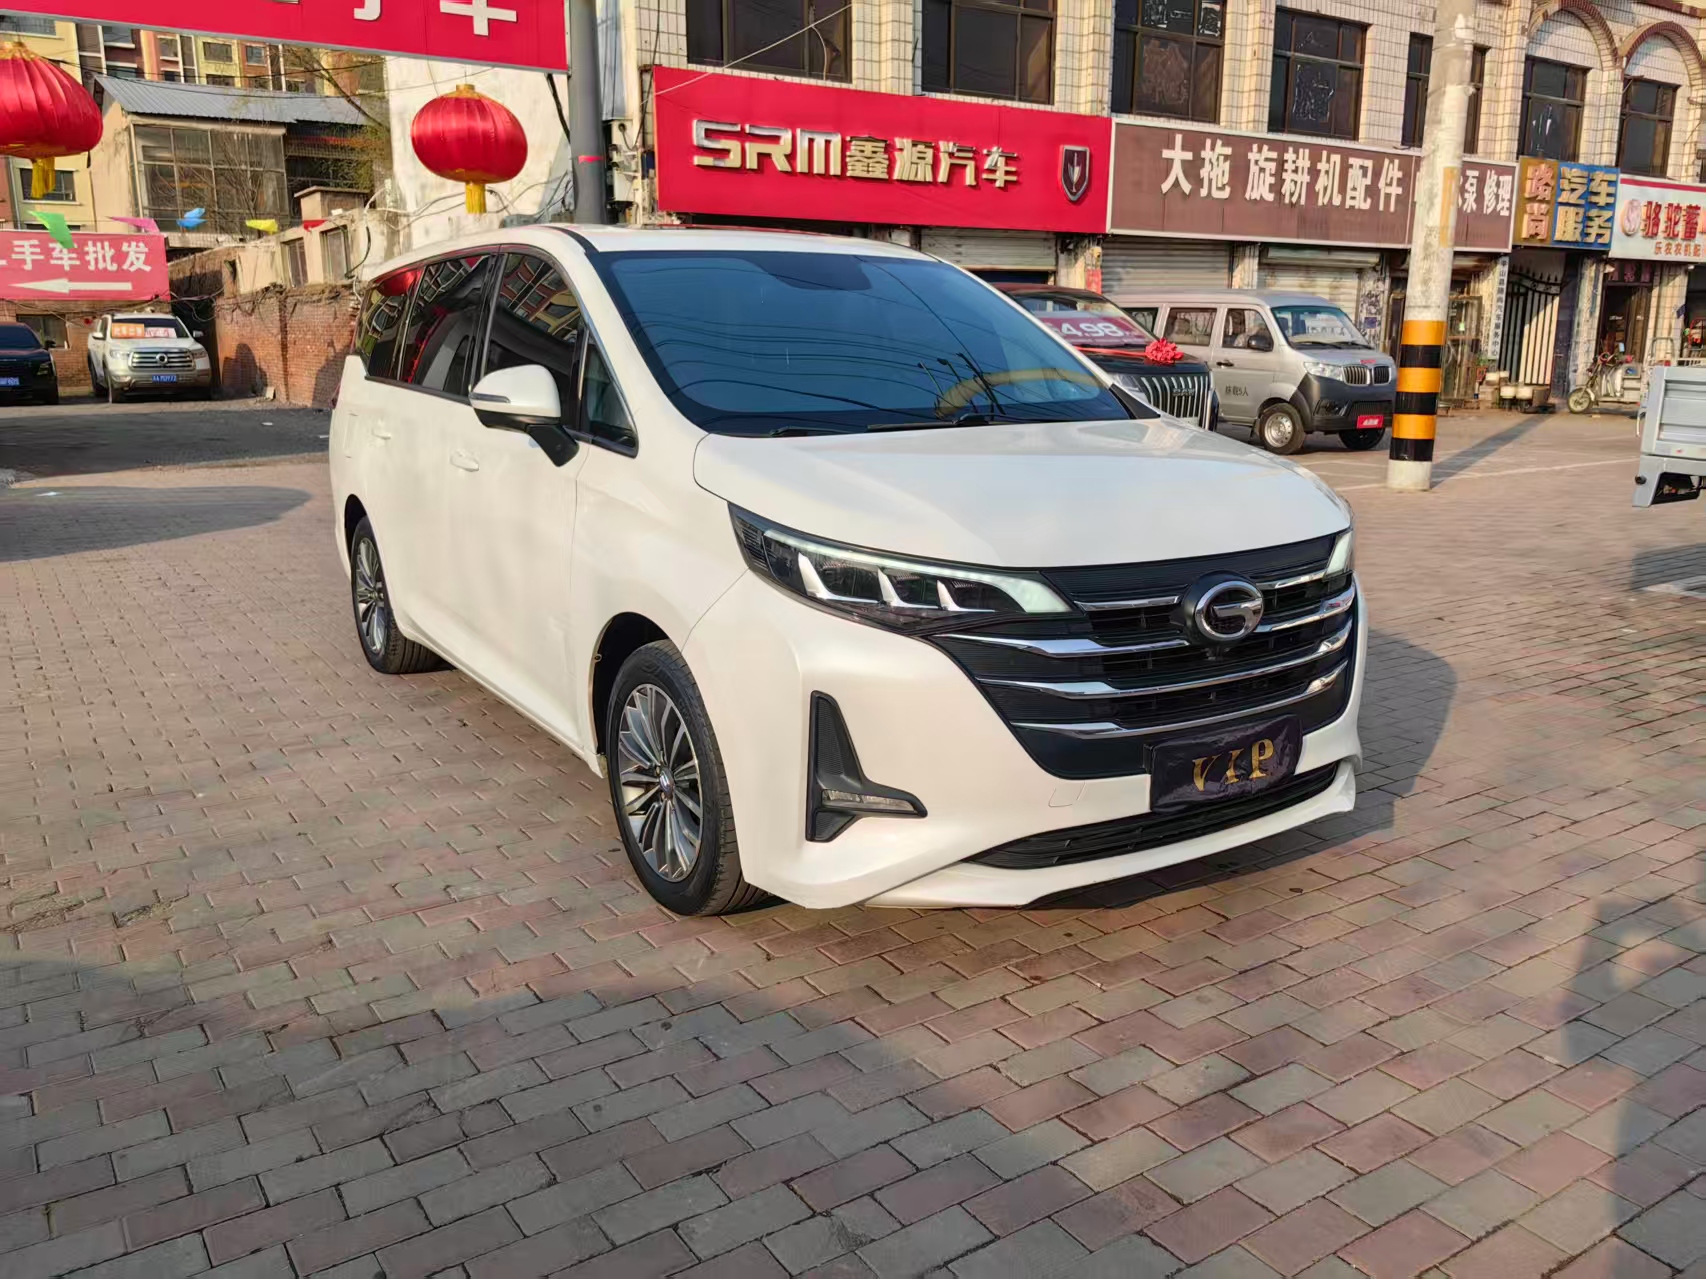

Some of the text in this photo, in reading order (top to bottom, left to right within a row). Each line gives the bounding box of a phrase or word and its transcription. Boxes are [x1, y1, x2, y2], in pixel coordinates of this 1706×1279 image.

[1483, 168, 1513, 217] 修理
[1640, 200, 1706, 240] 骆驼蓄
[0, 238, 152, 273] 手车批发
[1654, 241, 1706, 257] 乐农农机配
[1192, 738, 1274, 792] VIP
